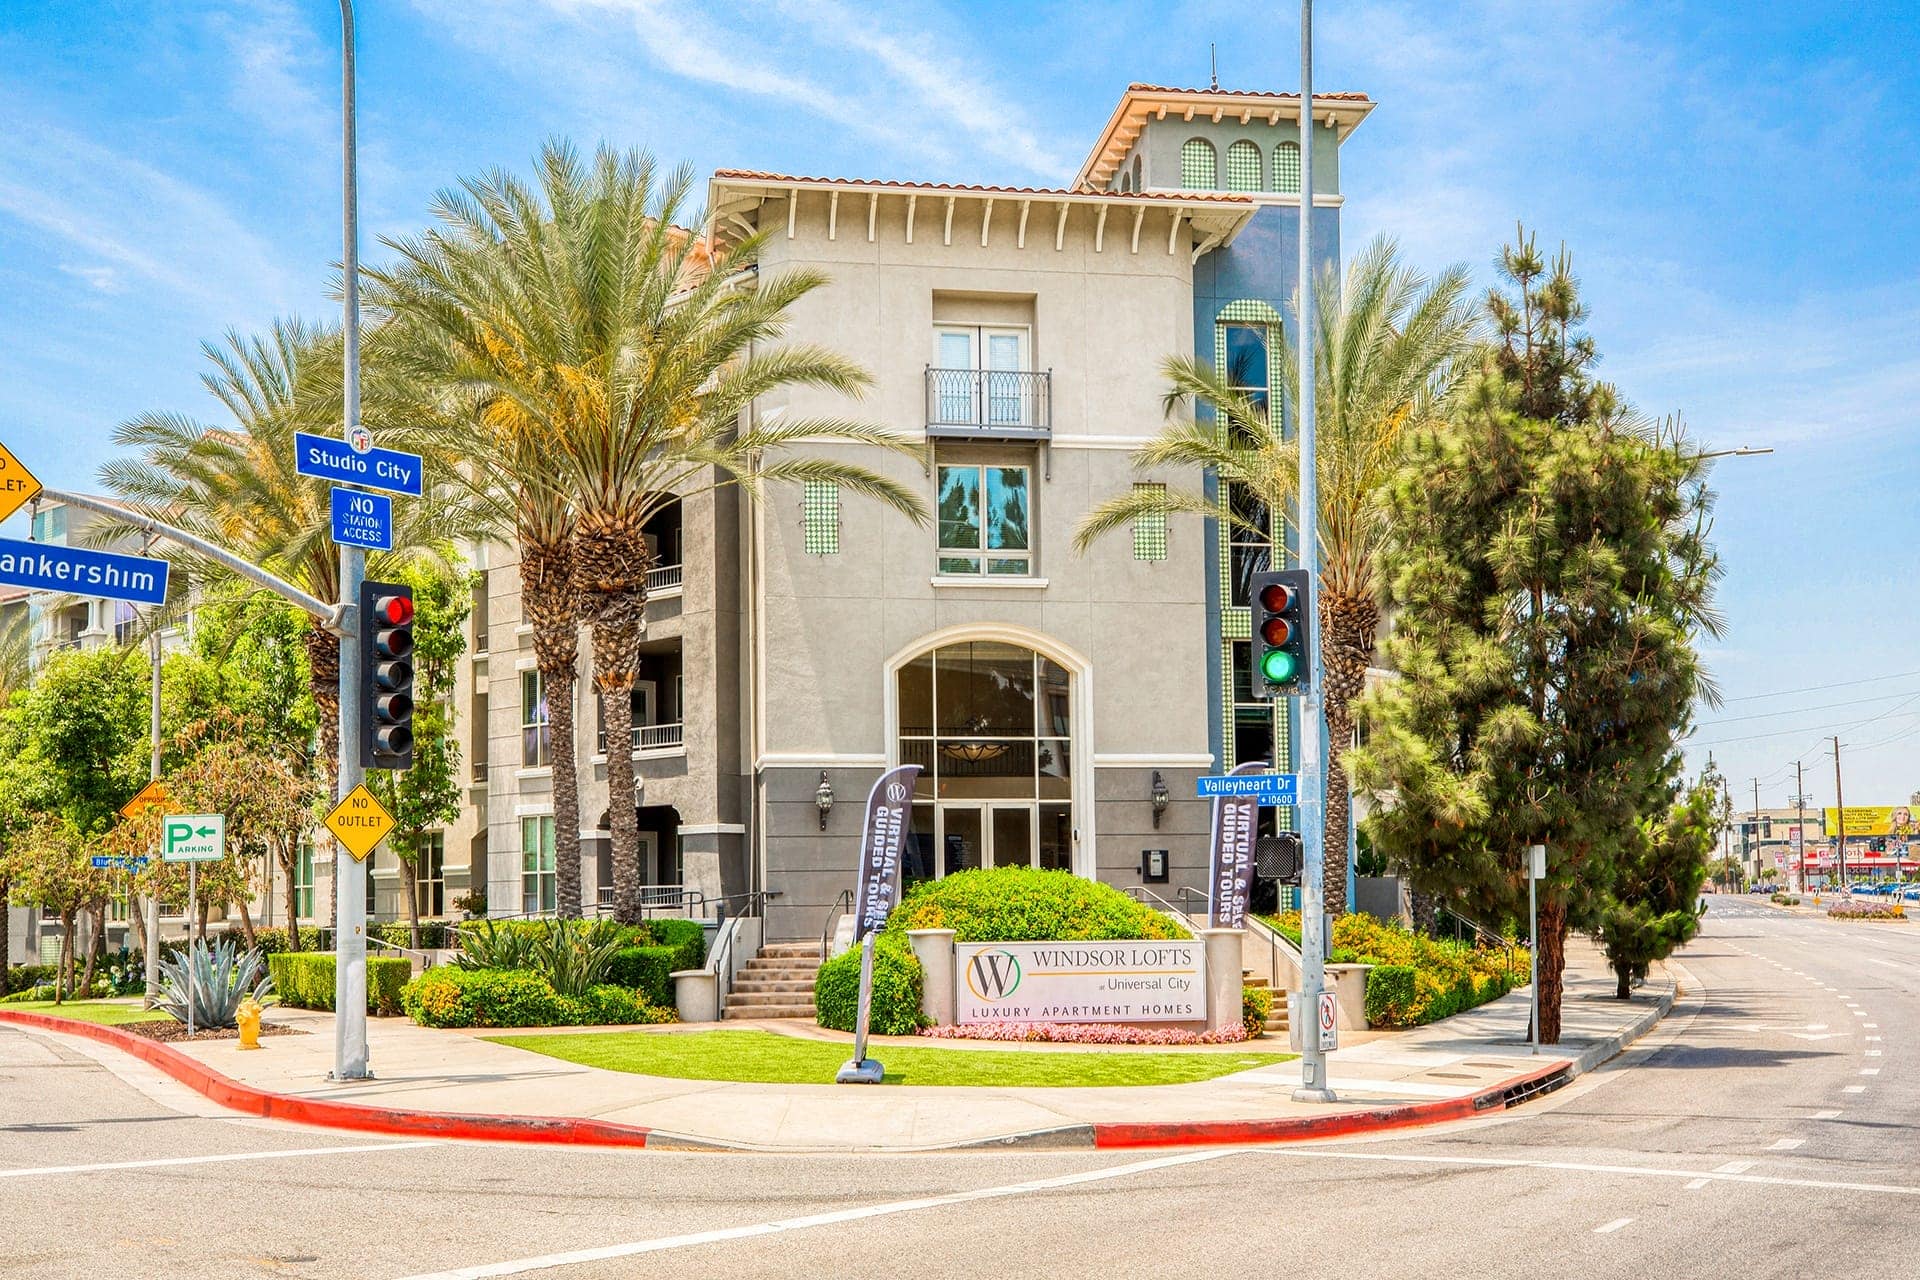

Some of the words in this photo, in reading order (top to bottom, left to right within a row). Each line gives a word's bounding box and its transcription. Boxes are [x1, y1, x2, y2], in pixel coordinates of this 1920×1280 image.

[309, 448, 367, 473] Studio
[376, 461, 411, 485] City
[349, 496, 374, 515] NO
[342, 513, 383, 529] STATION
[343, 528, 382, 542] ACCESS
[1204, 778, 1272, 795] Valleyheart
[1277, 777, 1291, 790] Dr
[352, 798, 368, 809] NO
[1268, 794, 1293, 804] 10600
[338, 815, 381, 827] OUTLET
[871, 806, 889, 869] GUIDED
[881, 807, 903, 878] VIRTUAL
[1221, 803, 1237, 864] GUIDED
[1235, 804, 1251, 873] VIRTUAL
[863, 872, 881, 929] TOURS
[1219, 868, 1233, 923] TOURS
[1033, 950, 1130, 967] WINDSOR
[1132, 949, 1192, 966] LOFTS
[1108, 977, 1162, 991] Universal
[1168, 977, 1191, 992] City
[972, 1007, 1030, 1018] LUXURY
[1042, 1005, 1131, 1017] APARTMENT
[1142, 1004, 1193, 1015] HOMES
